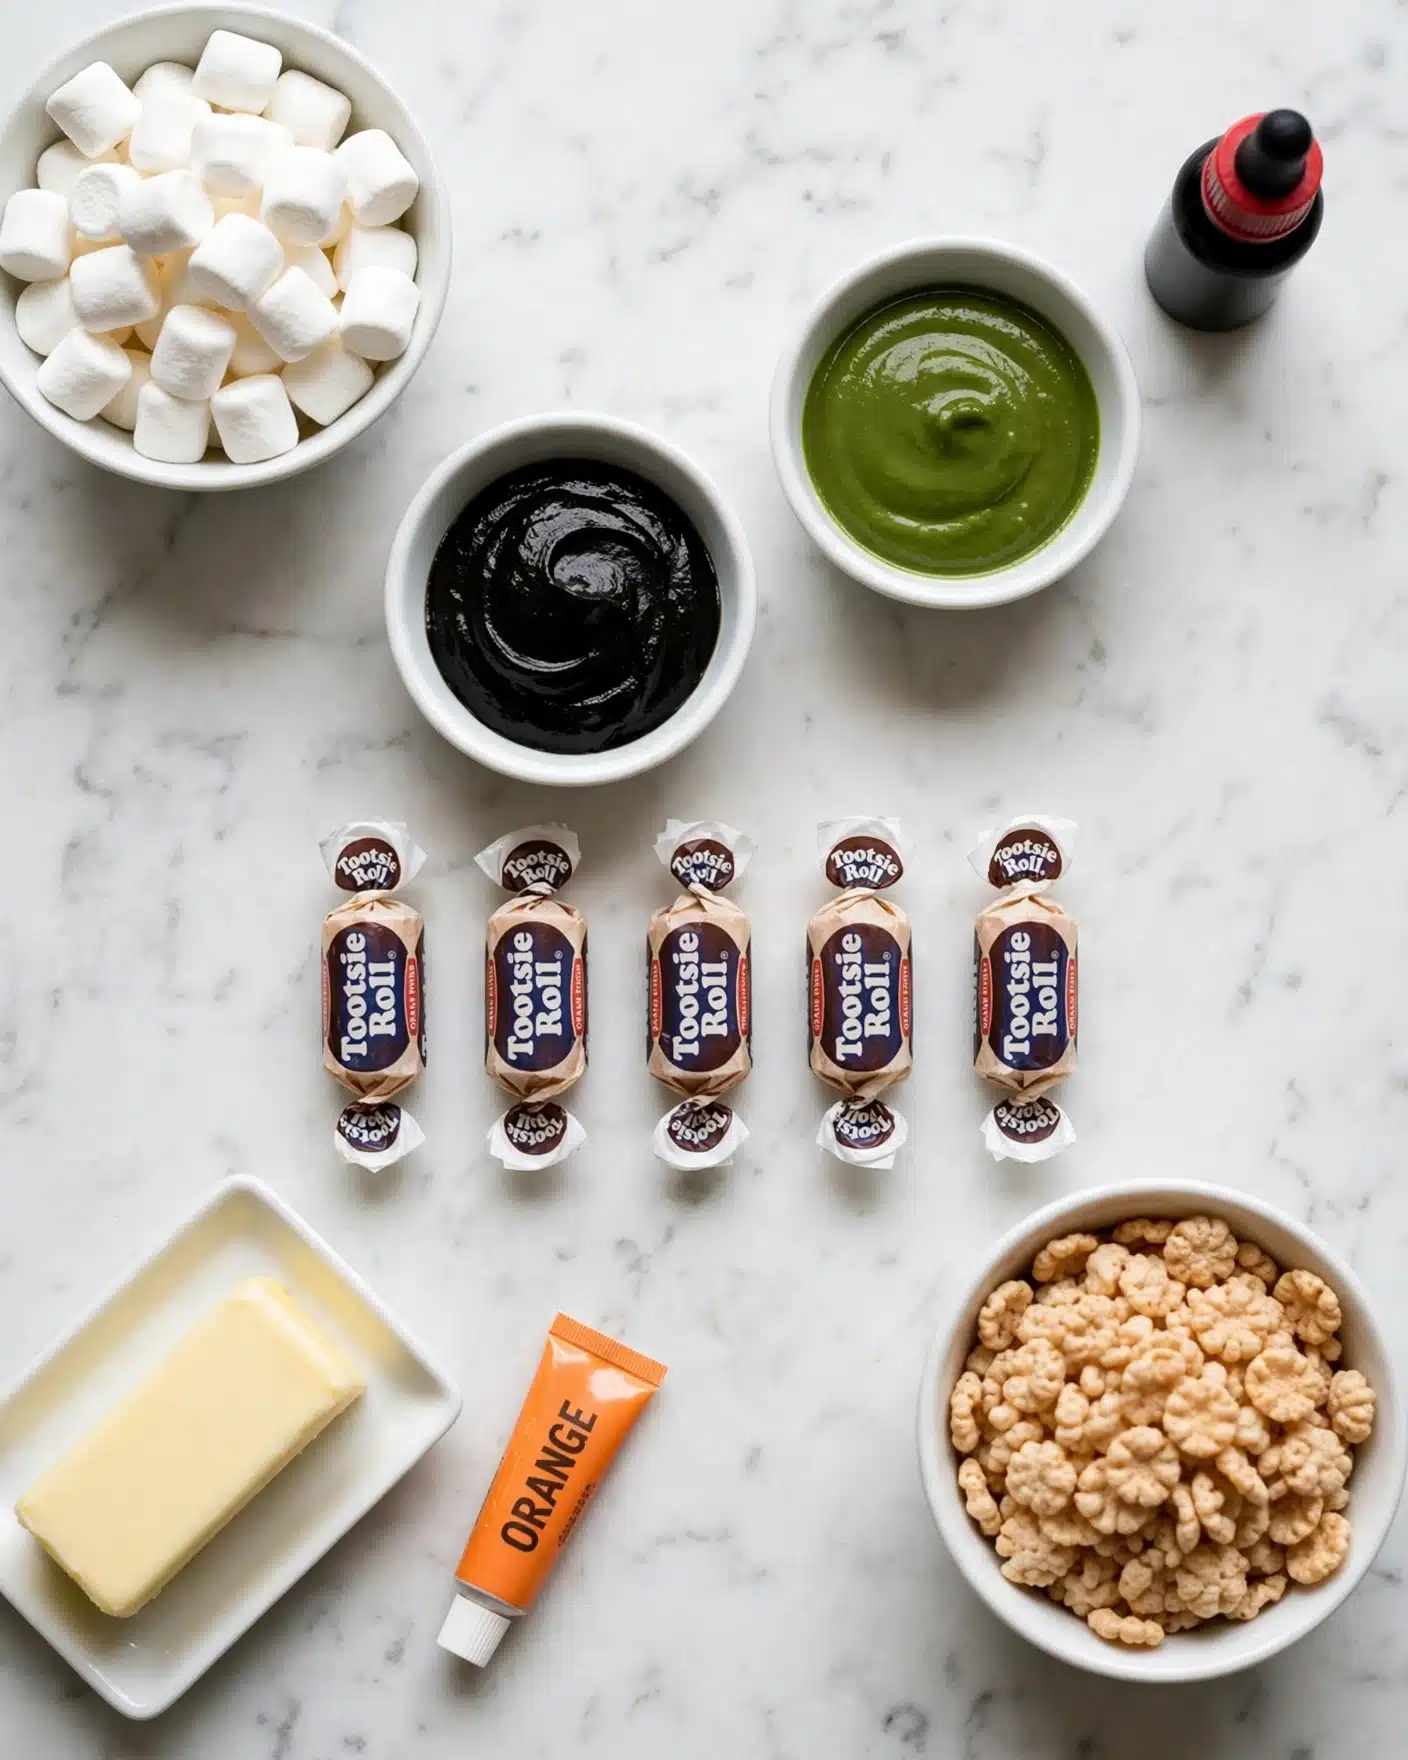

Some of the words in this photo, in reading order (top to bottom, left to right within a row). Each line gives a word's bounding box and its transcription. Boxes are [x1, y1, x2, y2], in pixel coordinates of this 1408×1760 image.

[337, 848, 398, 875] Tootsie
[503, 850, 570, 879] Tootsie
[672, 849, 732, 876] Tootsie
[831, 848, 899, 876] Tootsie
[993, 839, 1057, 866] Tootsie
[1003, 855, 1044, 877] Roll
[352, 865, 388, 886] Roll
[520, 865, 557, 885] Roll
[843, 863, 884, 883] Roll
[340, 932, 367, 1061] Tootsie
[368, 961, 396, 1037] Roll
[507, 932, 534, 1060] Tootsie
[535, 961, 562, 1036] Roll
[672, 932, 699, 1061] Tootsie
[701, 961, 728, 1037] Roll
[835, 933, 863, 1061] Tootsie
[863, 962, 891, 1038] Roll
[1003, 932, 1031, 1060] Tootsie
[1032, 961, 1058, 1036] Roll
[507, 1118, 564, 1146] Tootsie
[671, 1111, 728, 1144] Tootsie
[996, 1106, 1059, 1134] Tootsie
[501, 1400, 598, 1553] ORANGE
